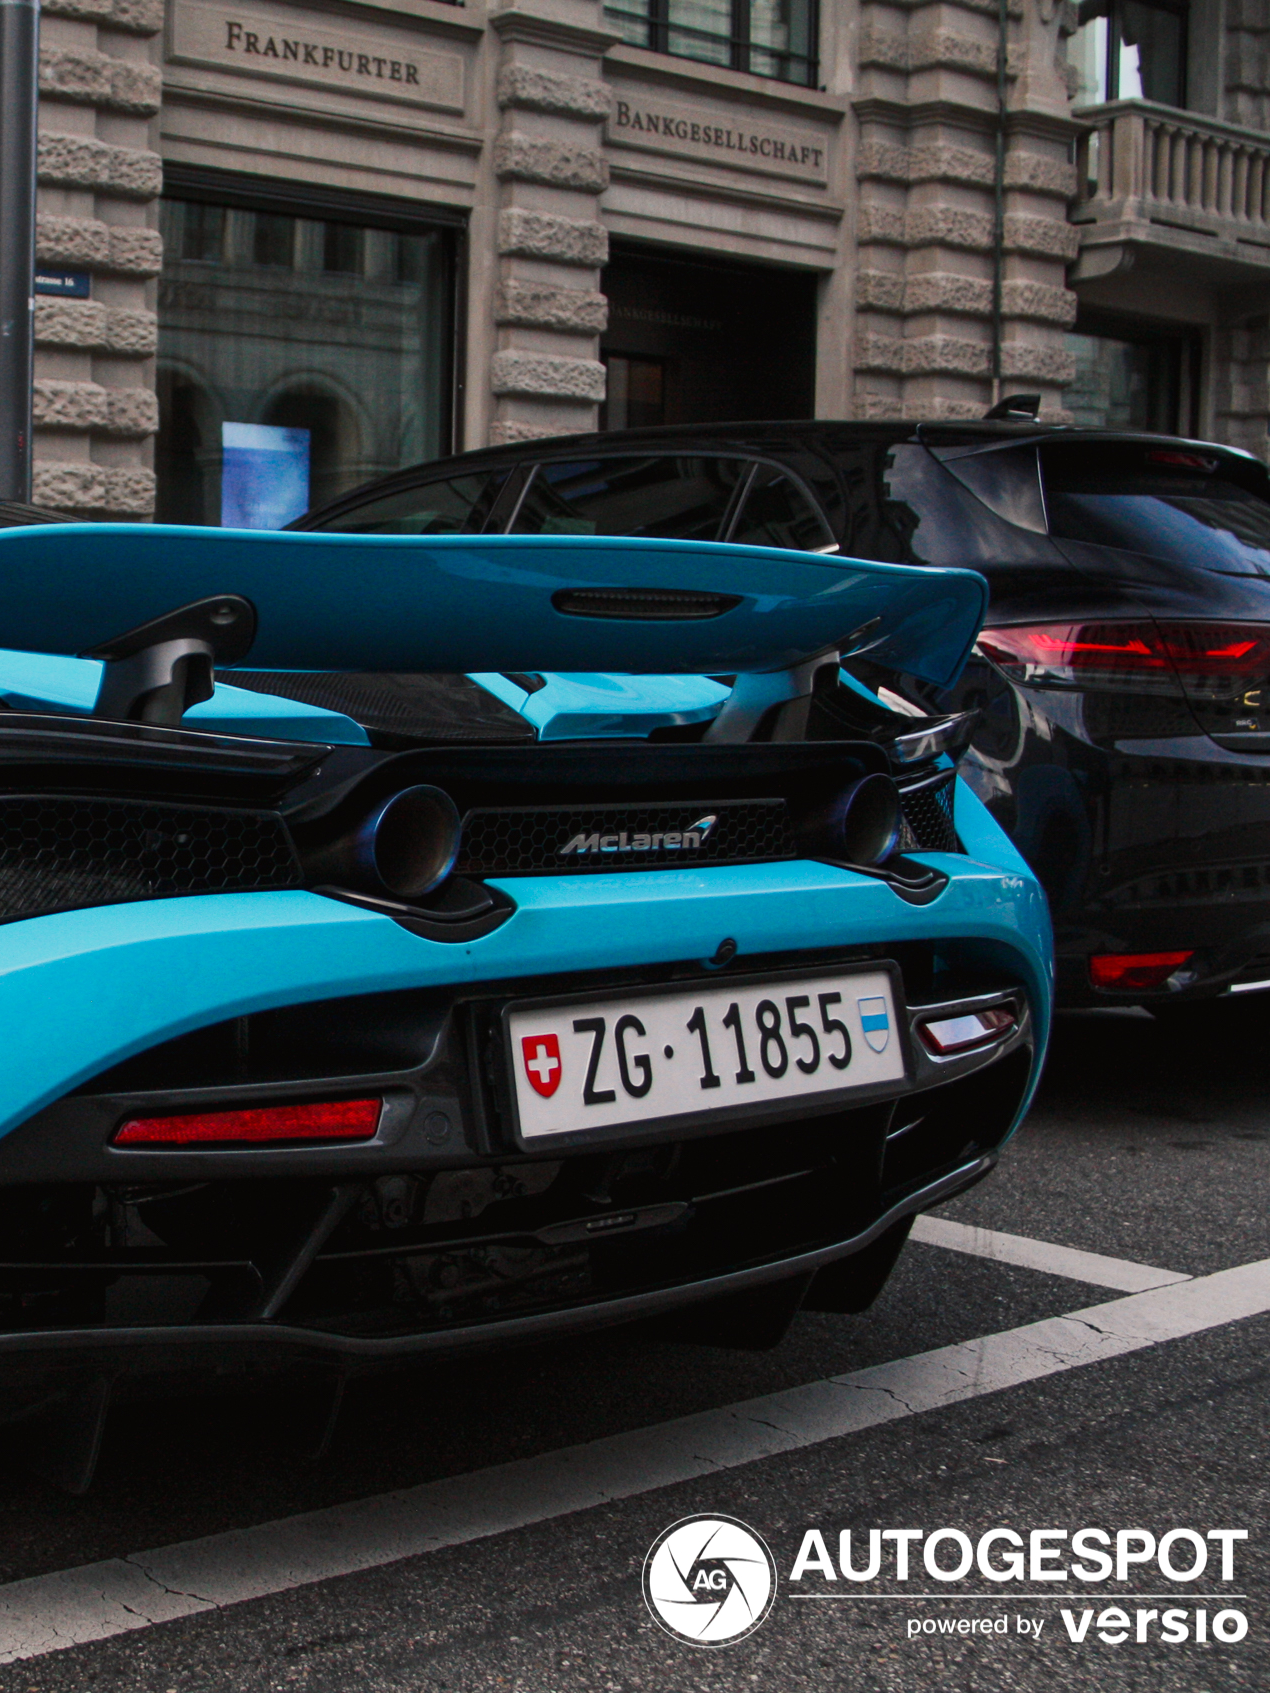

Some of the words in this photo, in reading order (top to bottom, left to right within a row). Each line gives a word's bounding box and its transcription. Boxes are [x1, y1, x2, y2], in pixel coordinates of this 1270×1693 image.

[225, 21, 420, 87] FRANKFURTER
[616, 100, 824, 170] BANKGESELLSCHAFT
[559, 831, 700, 855] McLaren
